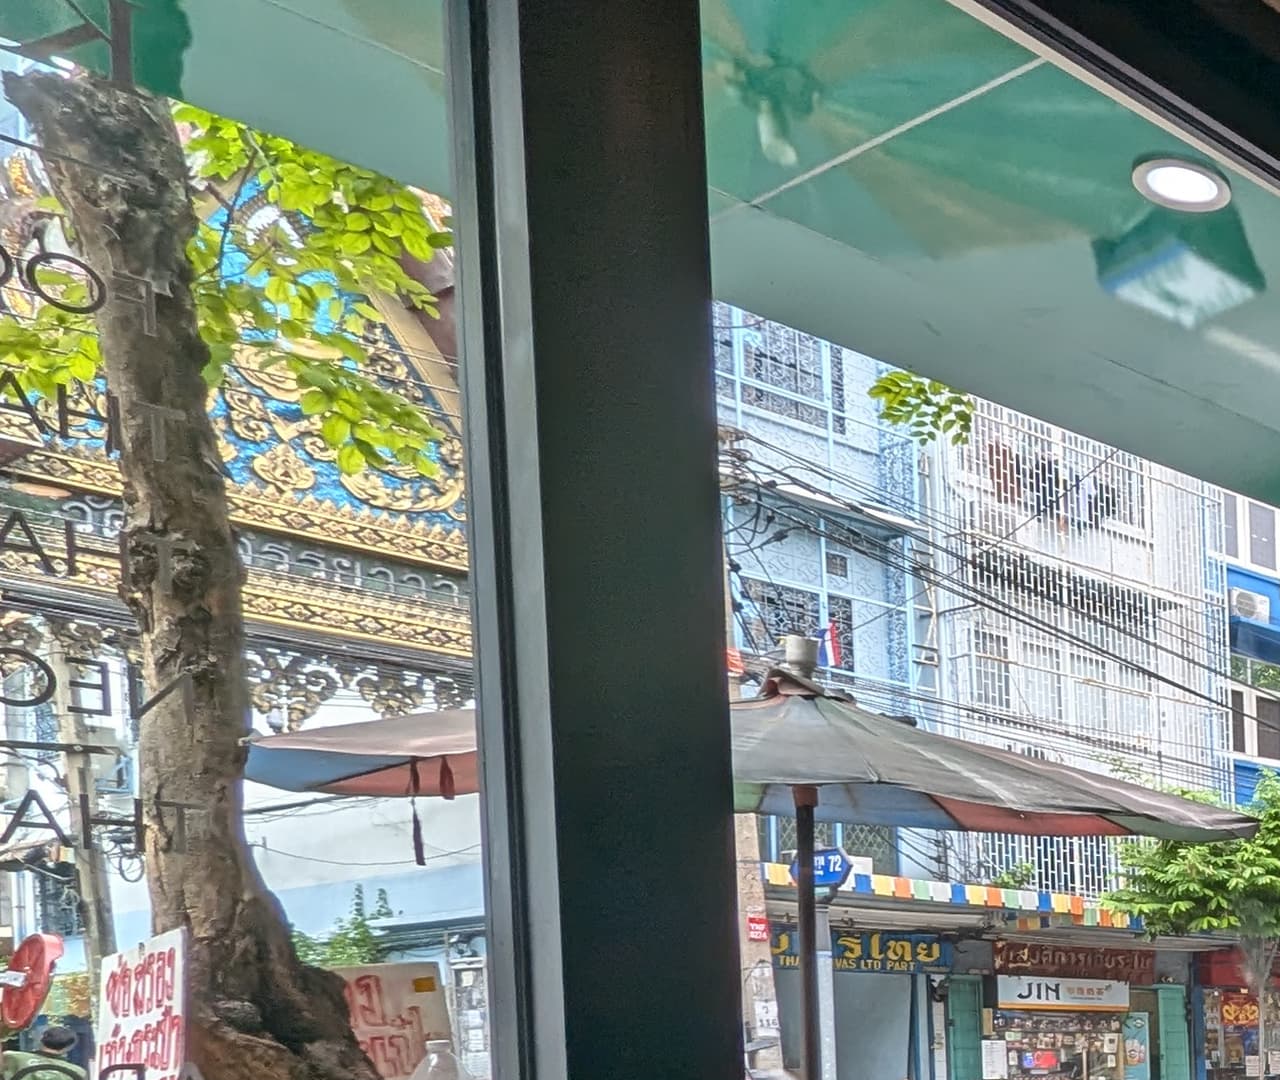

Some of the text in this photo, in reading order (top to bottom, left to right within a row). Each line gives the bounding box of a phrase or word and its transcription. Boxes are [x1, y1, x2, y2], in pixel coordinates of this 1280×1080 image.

[827, 854, 843, 873] 72
[860, 959, 881, 970] LTD
[886, 961, 916, 972] PART
[1017, 982, 1061, 1000] JIN
